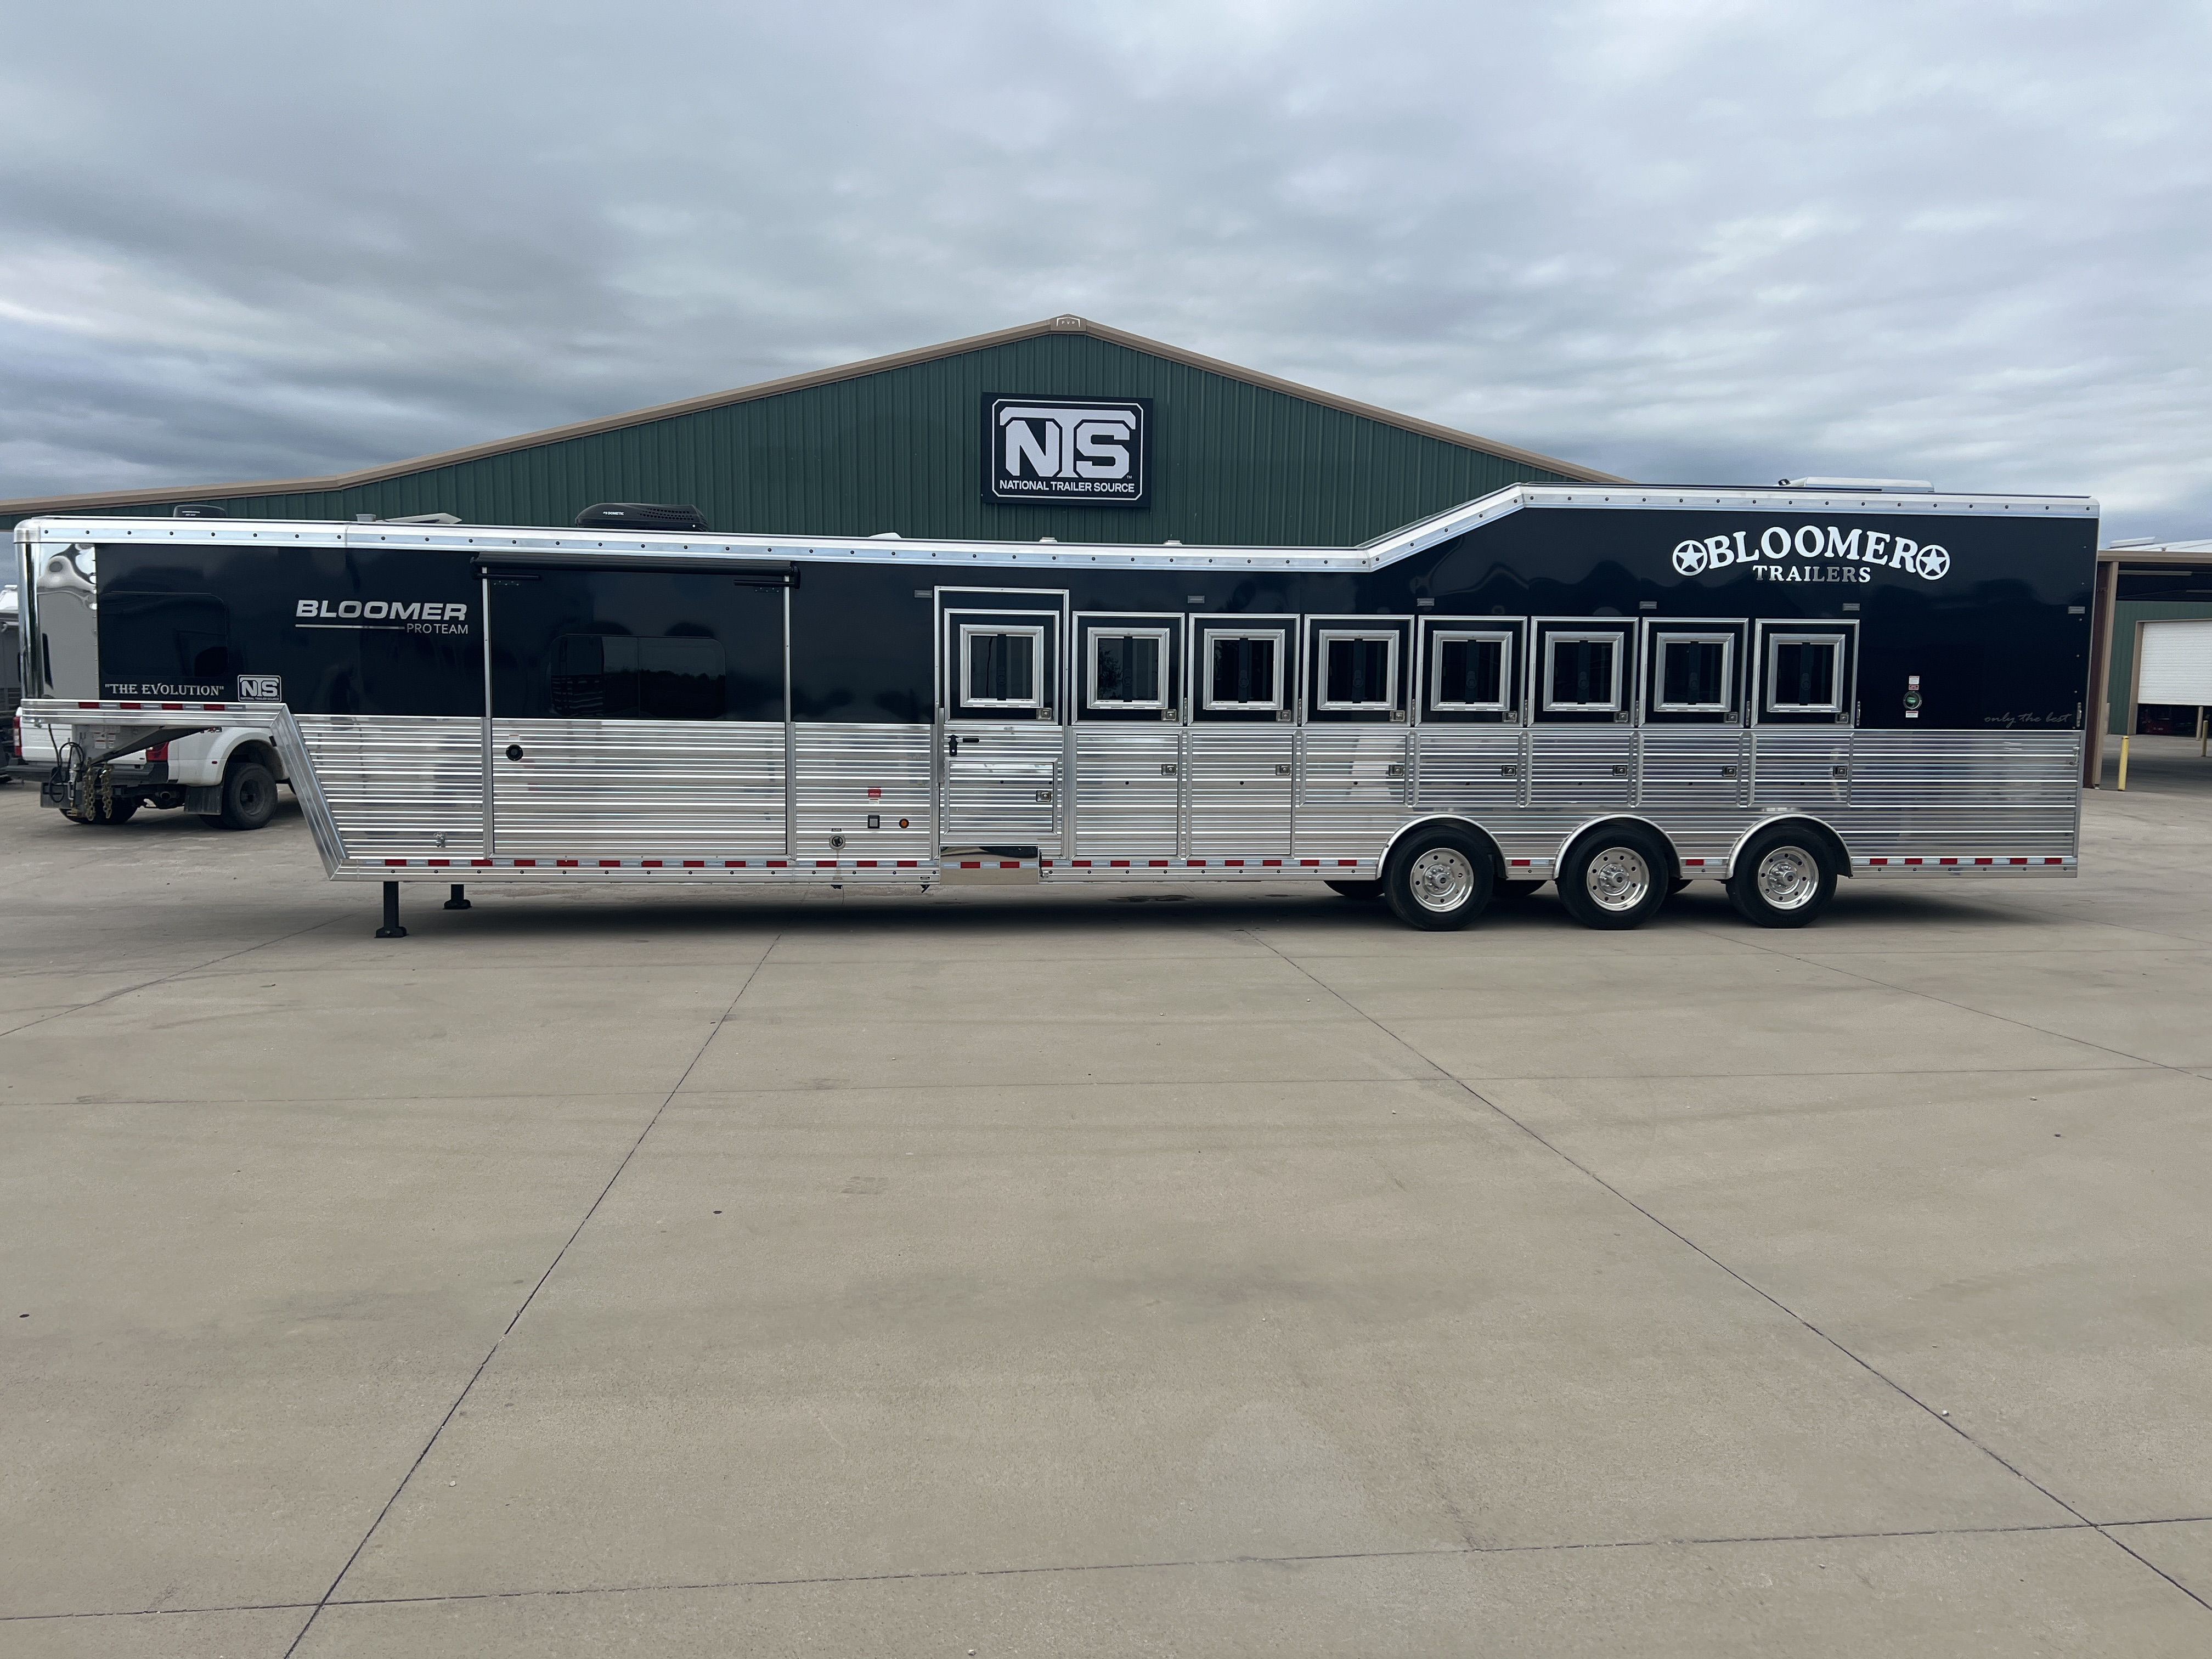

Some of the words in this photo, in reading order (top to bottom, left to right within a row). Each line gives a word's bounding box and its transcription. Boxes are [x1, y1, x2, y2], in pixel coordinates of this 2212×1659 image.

[1000, 407, 1136, 479] NTS
[1000, 479, 1049, 491] NATIONAL
[1050, 481, 1092, 492] TRAILER
[1093, 482, 1135, 493] SOURCE
[1704, 525, 1920, 574] BLOOMER
[1752, 565, 1871, 583] TRAILERS
[296, 600, 467, 620] BLOOMER
[105, 684, 138, 694] "THE
[142, 682, 224, 696] EVOLUTION"
[240, 677, 279, 697] NTS
[1984, 712, 2017, 728] only
[2017, 712, 2042, 722] the
[2046, 712, 2072, 723] best
